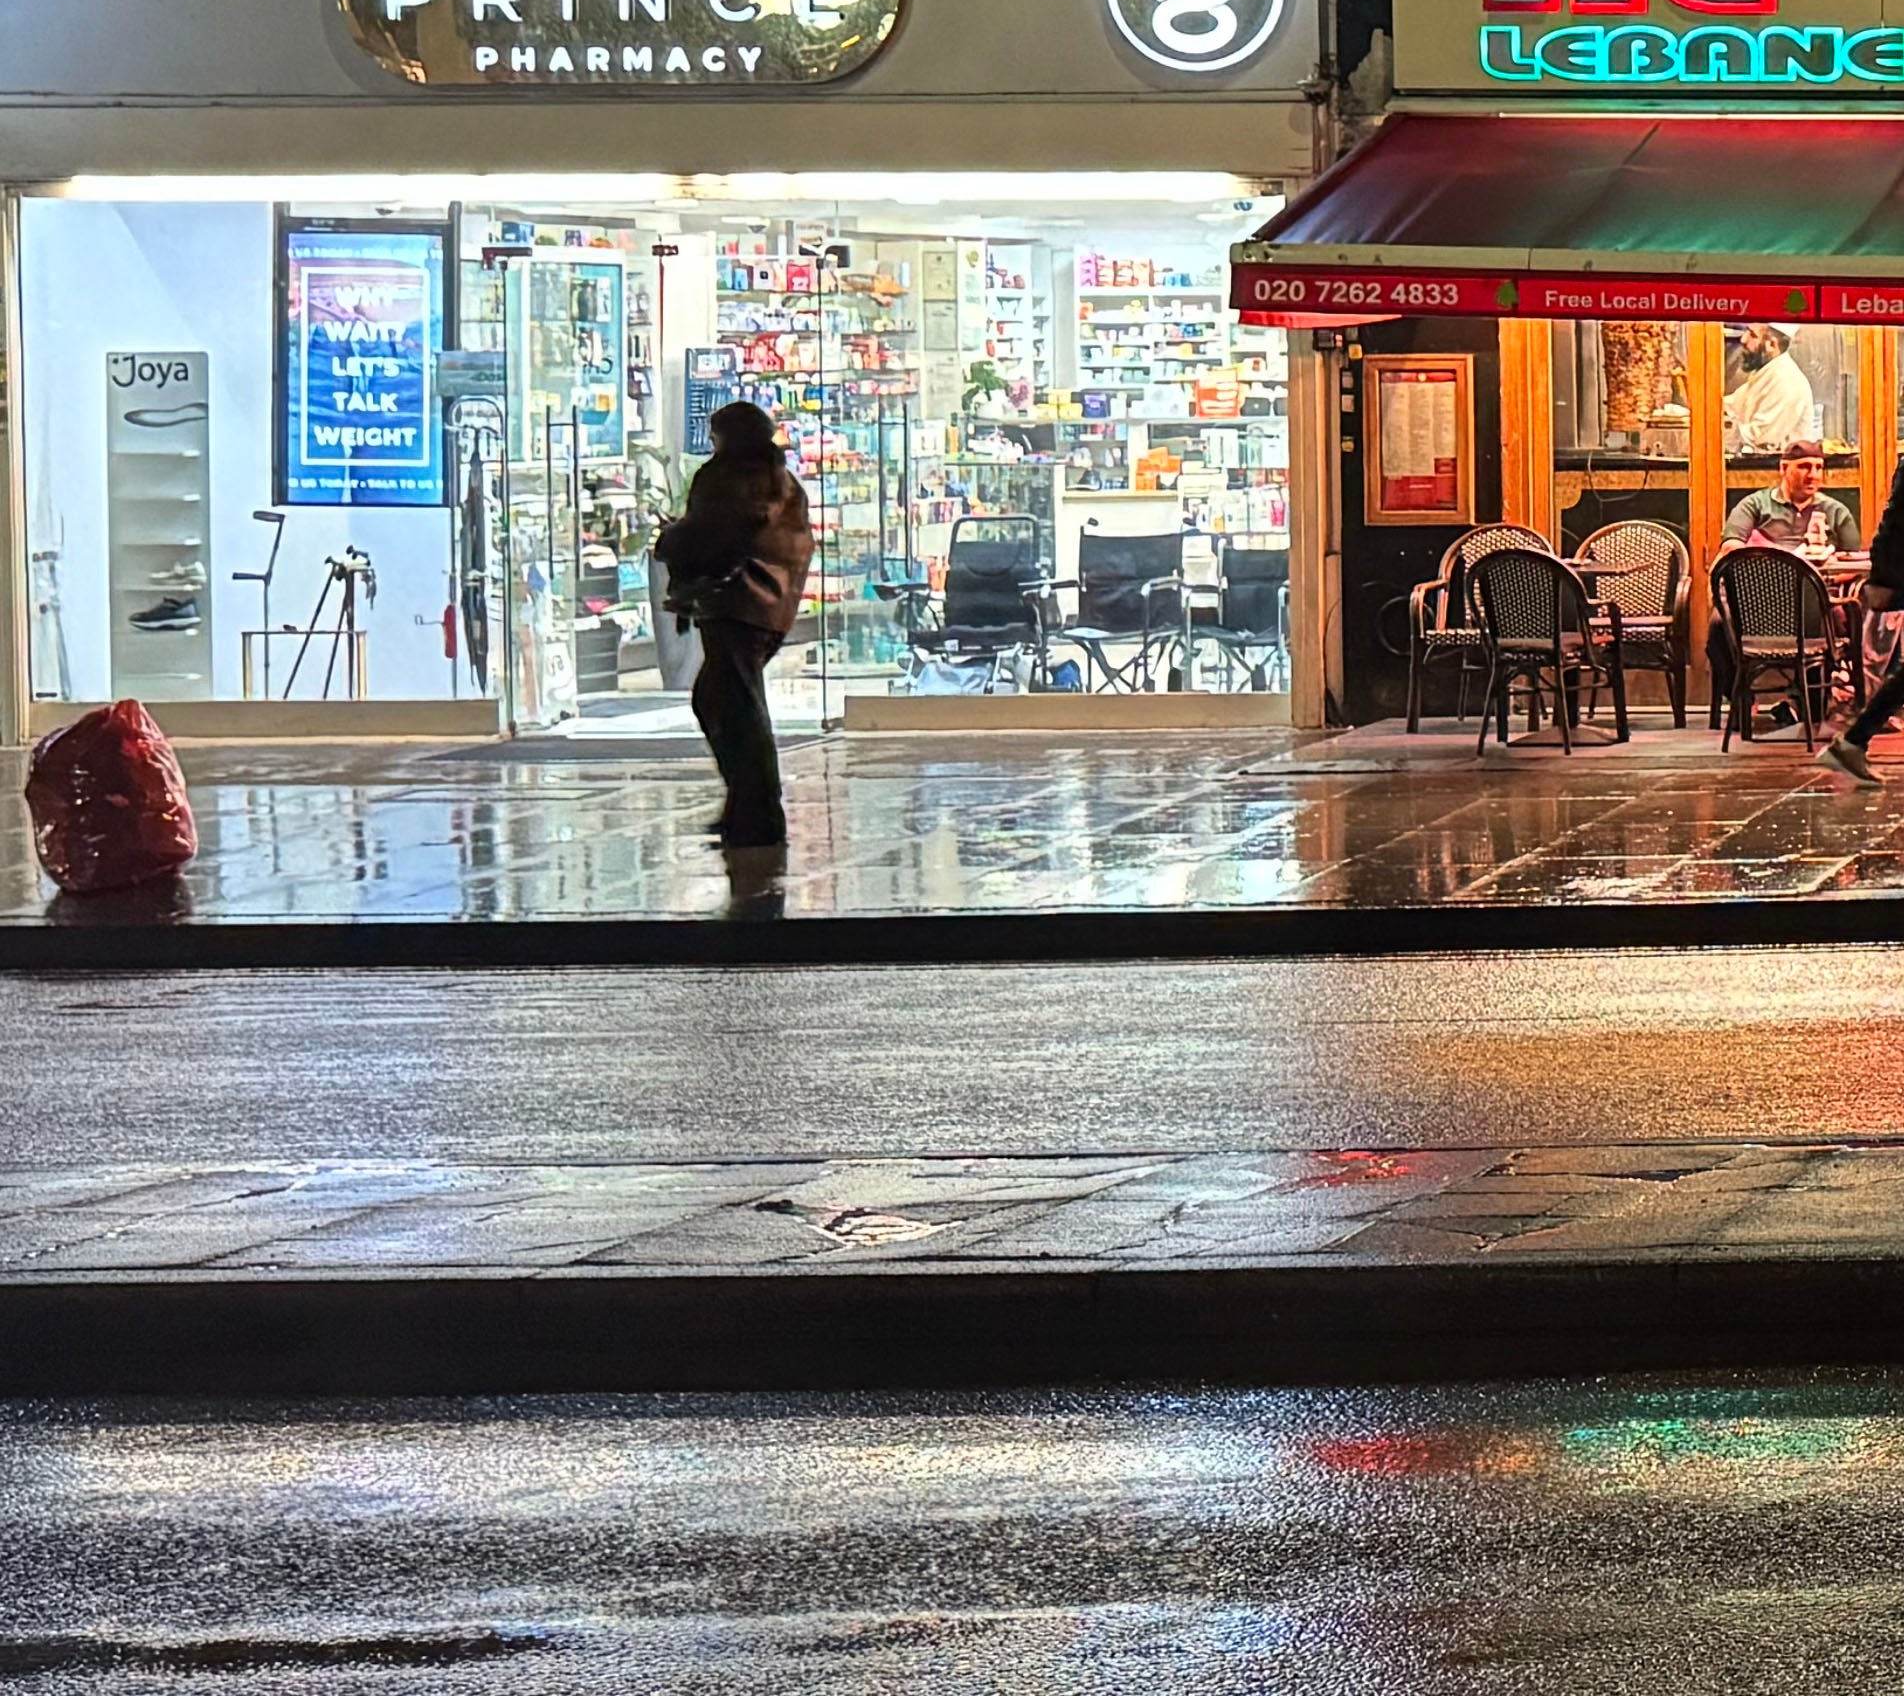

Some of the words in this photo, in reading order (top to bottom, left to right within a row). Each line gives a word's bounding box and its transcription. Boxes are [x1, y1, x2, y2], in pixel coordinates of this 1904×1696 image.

[475, 46, 764, 74] PHARMACY
[334, 286, 394, 307] WHY
[1254, 280, 1305, 303] 020
[1315, 281, 1382, 305] 7262
[1390, 282, 1459, 306] 4833
[1545, 290, 1592, 309] Free
[1599, 291, 1656, 310] Local
[1663, 291, 1749, 315] Delivery
[112, 354, 189, 389] Joya
[331, 356, 399, 377] LET'S
[331, 391, 398, 412] TALK
[313, 426, 418, 447] WEIGHT
